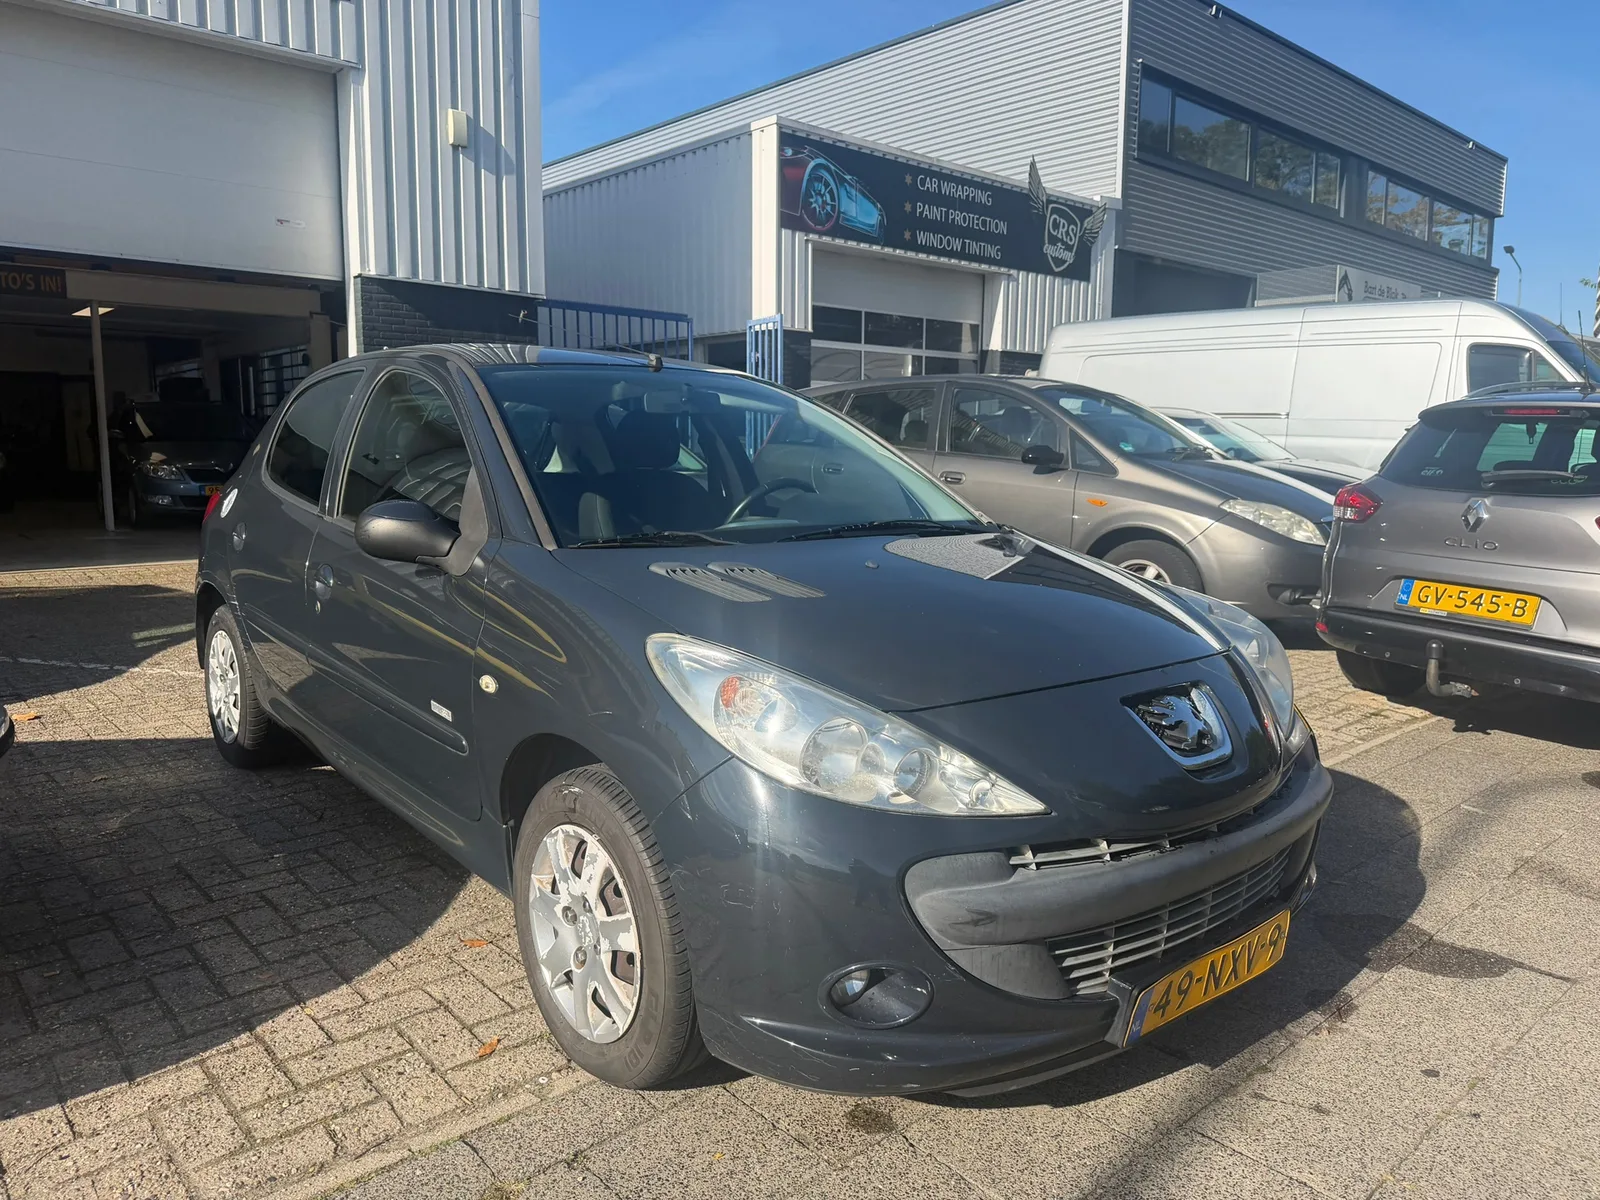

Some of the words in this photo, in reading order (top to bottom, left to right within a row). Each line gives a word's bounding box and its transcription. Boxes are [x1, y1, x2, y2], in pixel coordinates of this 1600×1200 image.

[917, 175, 938, 194] CAR
[940, 180, 992, 206] WRAPPING
[916, 202, 947, 222] PAINT
[948, 209, 1008, 235] PROTECTION
[1049, 214, 1076, 245] CRS
[916, 230, 963, 252] WINDOW
[964, 239, 1002, 260] TINTING
[1043, 242, 1075, 264] customs
[40, 274, 62, 293] IN!
[1444, 537, 1498, 551] CLIO
[1417, 585, 1529, 618] GV-545-B
[1153, 922, 1282, 1019] 49-NXV-9
